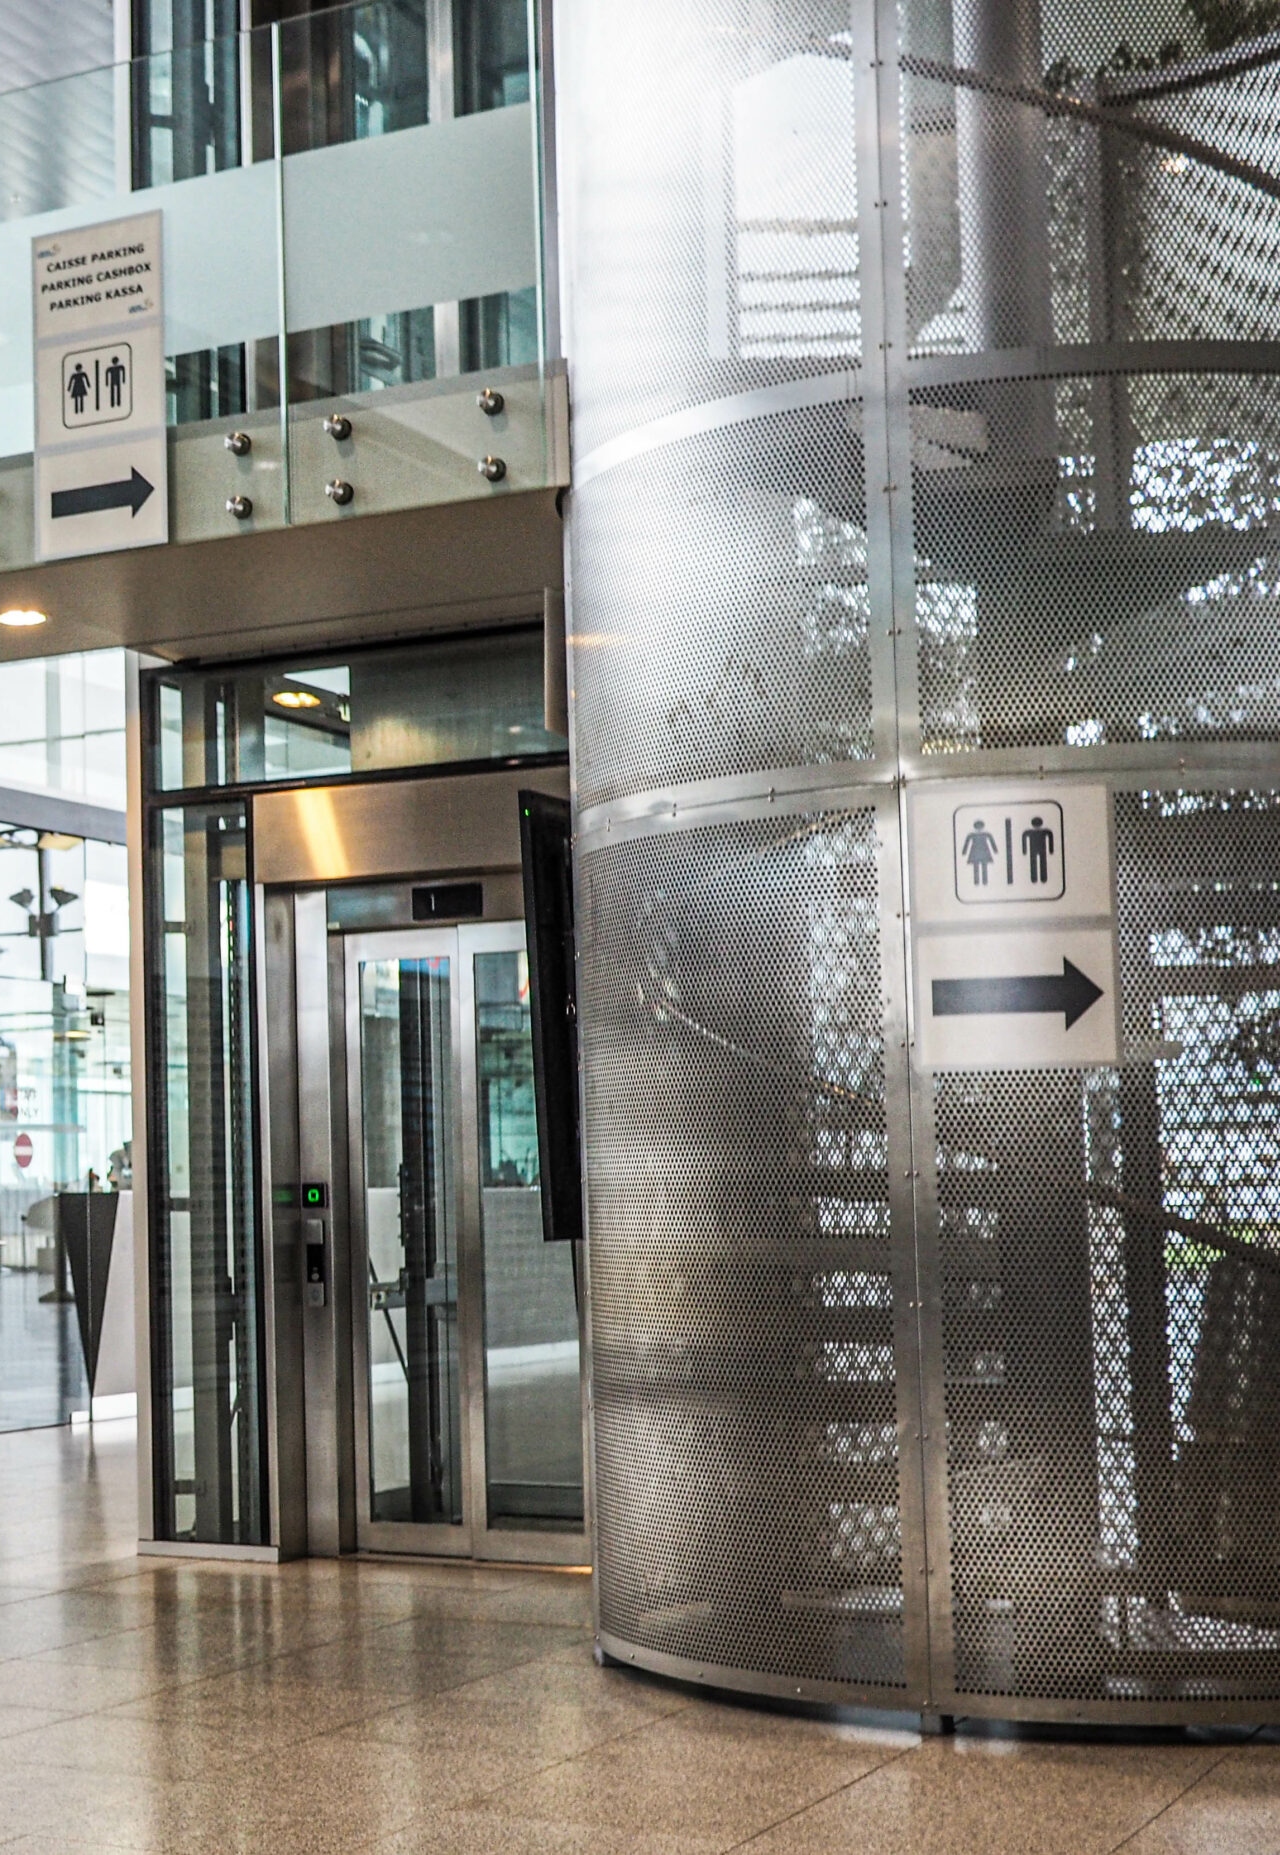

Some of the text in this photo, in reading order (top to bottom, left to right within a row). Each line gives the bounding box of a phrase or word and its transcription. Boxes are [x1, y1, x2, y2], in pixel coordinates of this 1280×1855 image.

[46, 243, 145, 273] CAISSE PARKING
[41, 262, 151, 294] PARKING CASHBOX
[49, 283, 143, 311] PARKING KASSA
